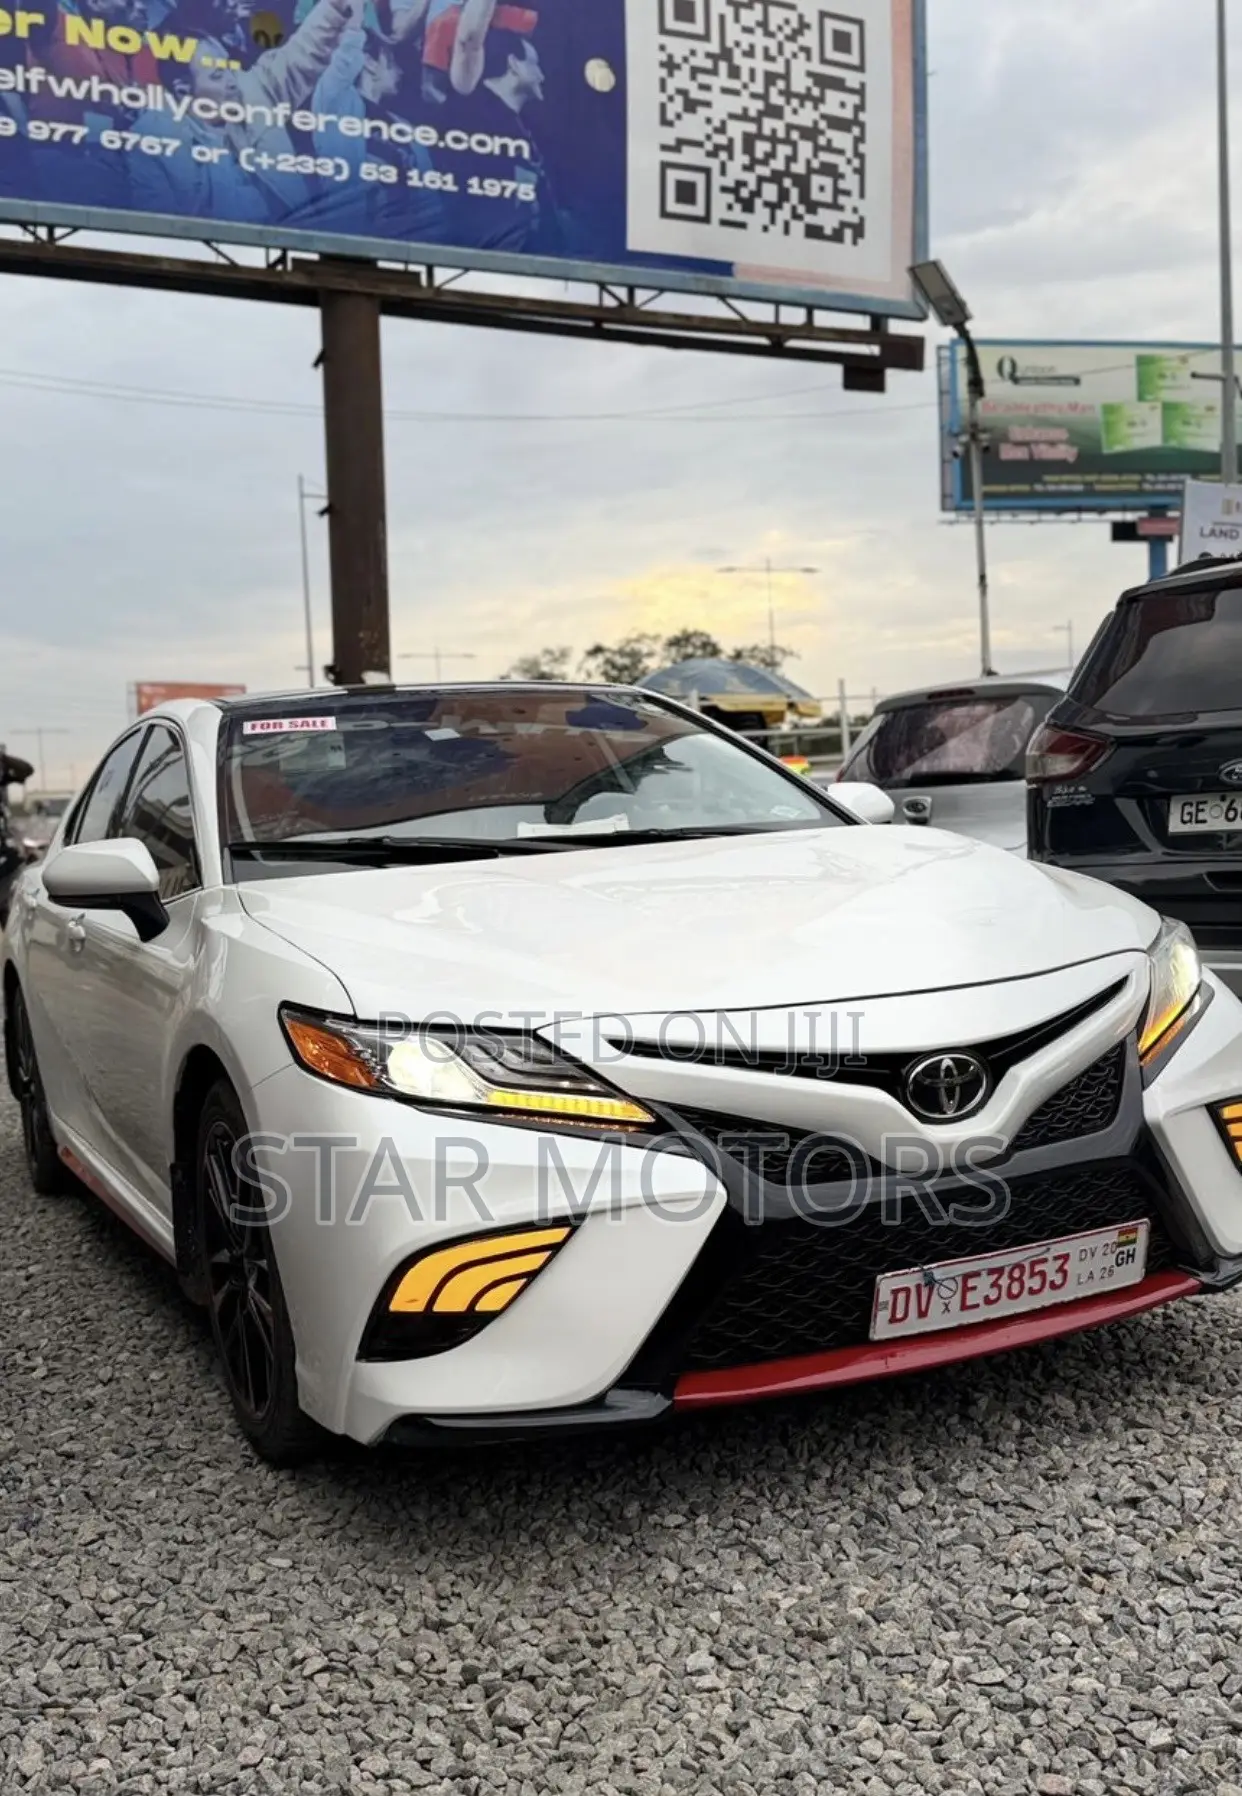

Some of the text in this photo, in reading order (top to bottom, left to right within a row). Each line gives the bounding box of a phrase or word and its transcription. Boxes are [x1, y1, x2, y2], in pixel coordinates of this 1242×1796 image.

[65, 15, 241, 71] Now...
[27, 120, 88, 145] 977
[100, 129, 181, 157] 6767
[191, 144, 229, 165] or
[239, 147, 349, 182] (+233)
[359, 162, 398, 184] 53
[407, 168, 459, 193] 161
[467, 176, 536, 202] 1975
[1200, 526, 1240, 541] LAND
[250, 719, 329, 731] FOR SALE
[1181, 798, 1242, 824] GE 6
[1115, 1247, 1137, 1268] GH
[888, 1283, 936, 1324] DV
[960, 1252, 1071, 1312] E3853
